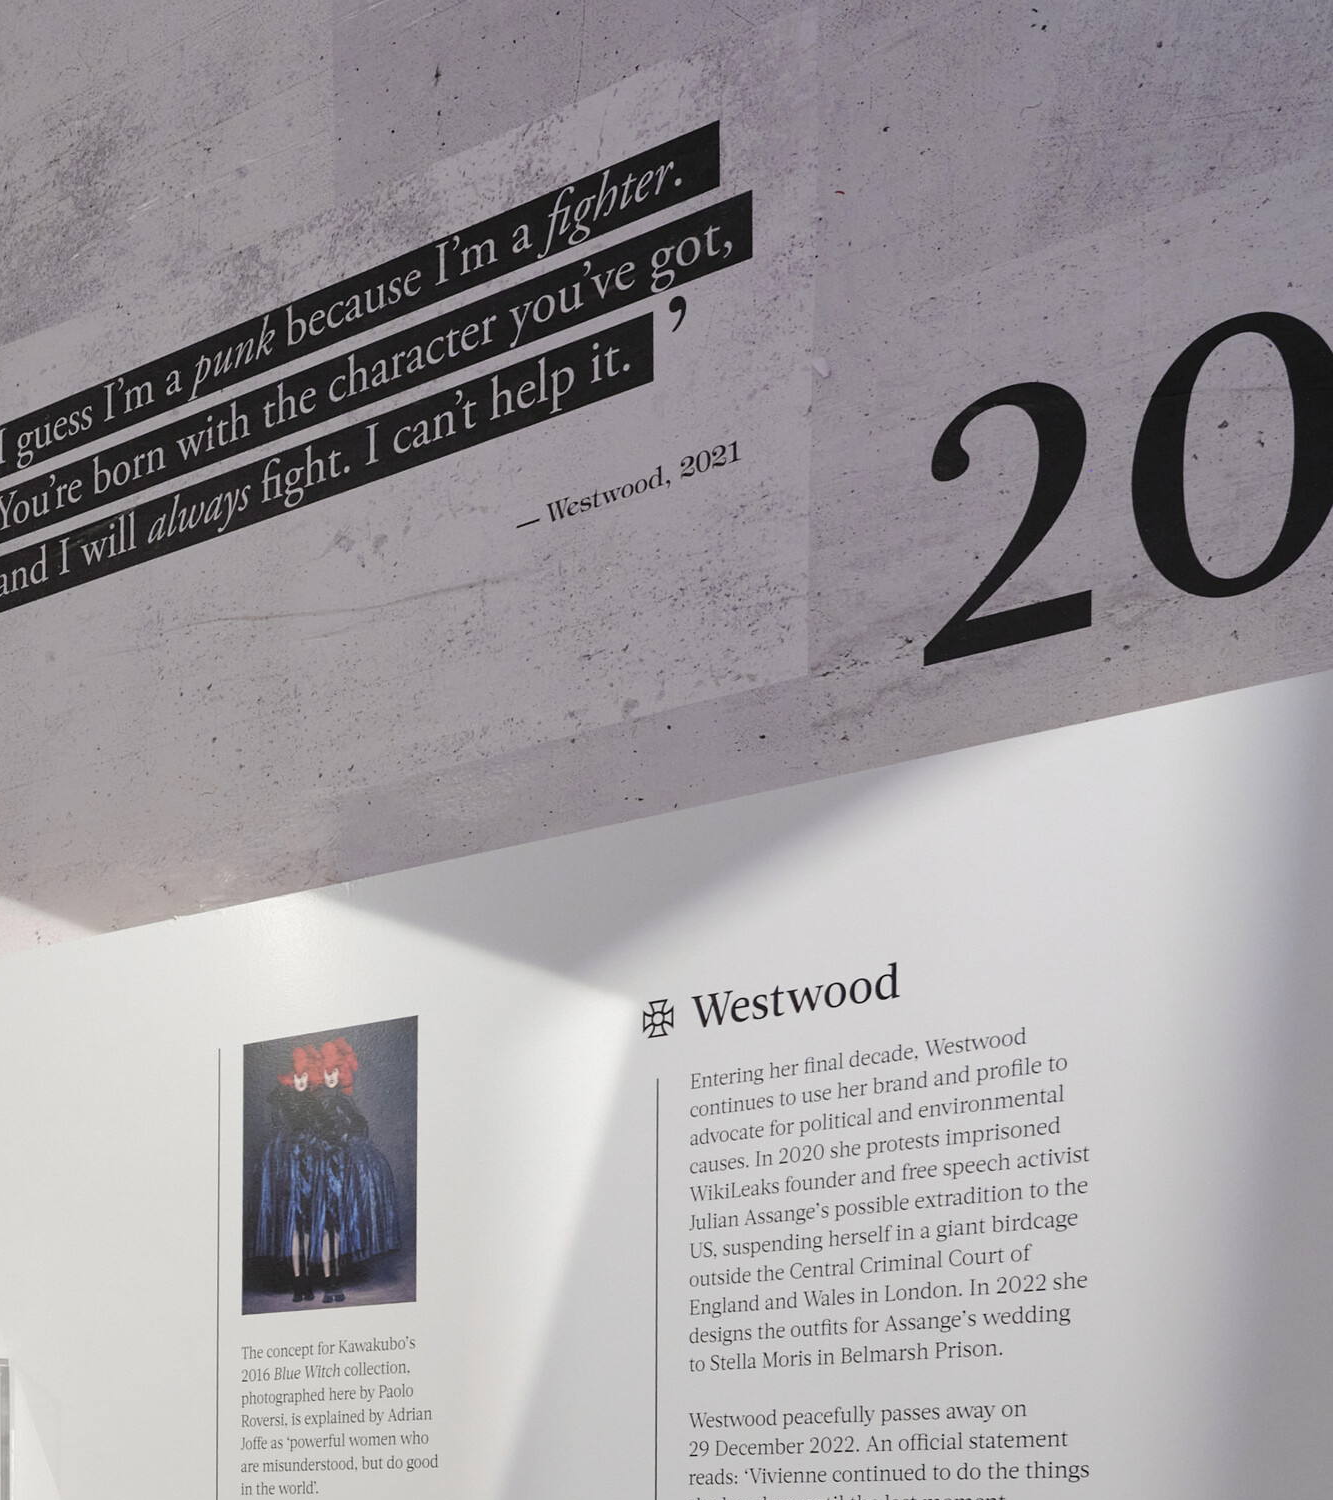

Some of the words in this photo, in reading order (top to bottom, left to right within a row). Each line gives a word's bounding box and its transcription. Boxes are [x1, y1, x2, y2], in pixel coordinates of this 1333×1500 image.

[17, 406, 92, 469] guess
[104, 378, 154, 421] I’m
[166, 370, 182, 395] a
[188, 315, 275, 401] punk
[286, 270, 421, 346] because
[436, 236, 498, 285] I’m
[513, 225, 532, 253] a
[537, 161, 681, 259] fighter.
[93, 448, 166, 494] born
[176, 401, 250, 460] with
[263, 382, 316, 428] the
[329, 315, 496, 402] character
[509, 261, 635, 347] you’ve
[651, 226, 732, 293] got,
[59, 537, 69, 575] I
[81, 511, 136, 565] will
[148, 485, 251, 543] always
[262, 445, 350, 507] fight.
[366, 423, 379, 465] I
[394, 390, 476, 453] can’t
[490, 357, 574, 420] help
[547, 466, 670, 522] Westwood,
[681, 441, 740, 478] 2021
[923, 311, 1333, 667] 20
[692, 962, 899, 1027] Westwood
[691, 1068, 764, 1089] Entering
[770, 1062, 799, 1078] her
[805, 1053, 843, 1074] final
[849, 1044, 918, 1067] decade,
[925, 1027, 1026, 1056] Westwood
[241, 1346, 263, 1359] The
[267, 1345, 313, 1359] concept
[318, 1342, 335, 1355] for
[339, 1336, 415, 1353] Kawakubo’s
[689, 1409, 777, 1428] Westwood
[783, 1406, 874, 1429] peacefully
[881, 1407, 940, 1426] passes
[947, 1406, 995, 1422] away
[1002, 1404, 1027, 1417] on
